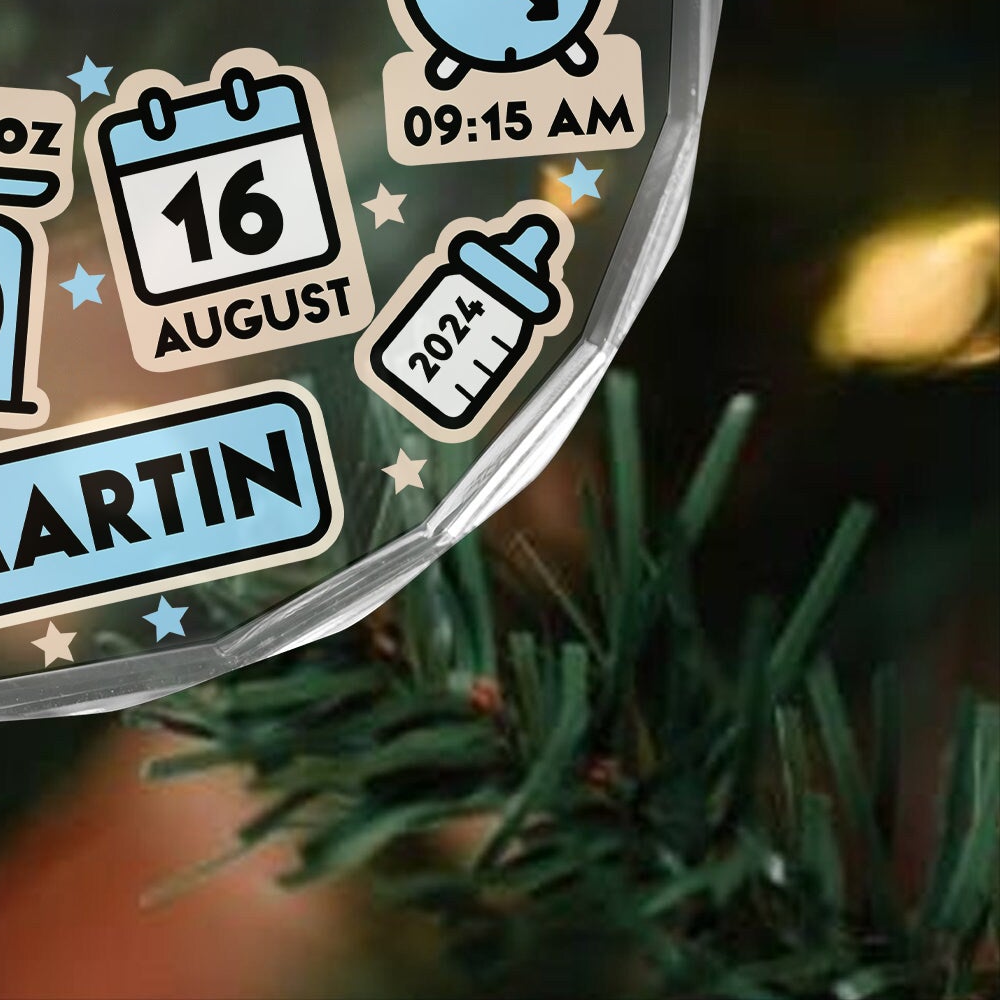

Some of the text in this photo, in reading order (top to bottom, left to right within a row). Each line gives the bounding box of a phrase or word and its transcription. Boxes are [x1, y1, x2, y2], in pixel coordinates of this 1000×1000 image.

[403, 94, 635, 147] 09:15 AM
[161, 159, 284, 263] 16
[154, 276, 351, 359] AUGUST
[408, 295, 486, 384] 2024
